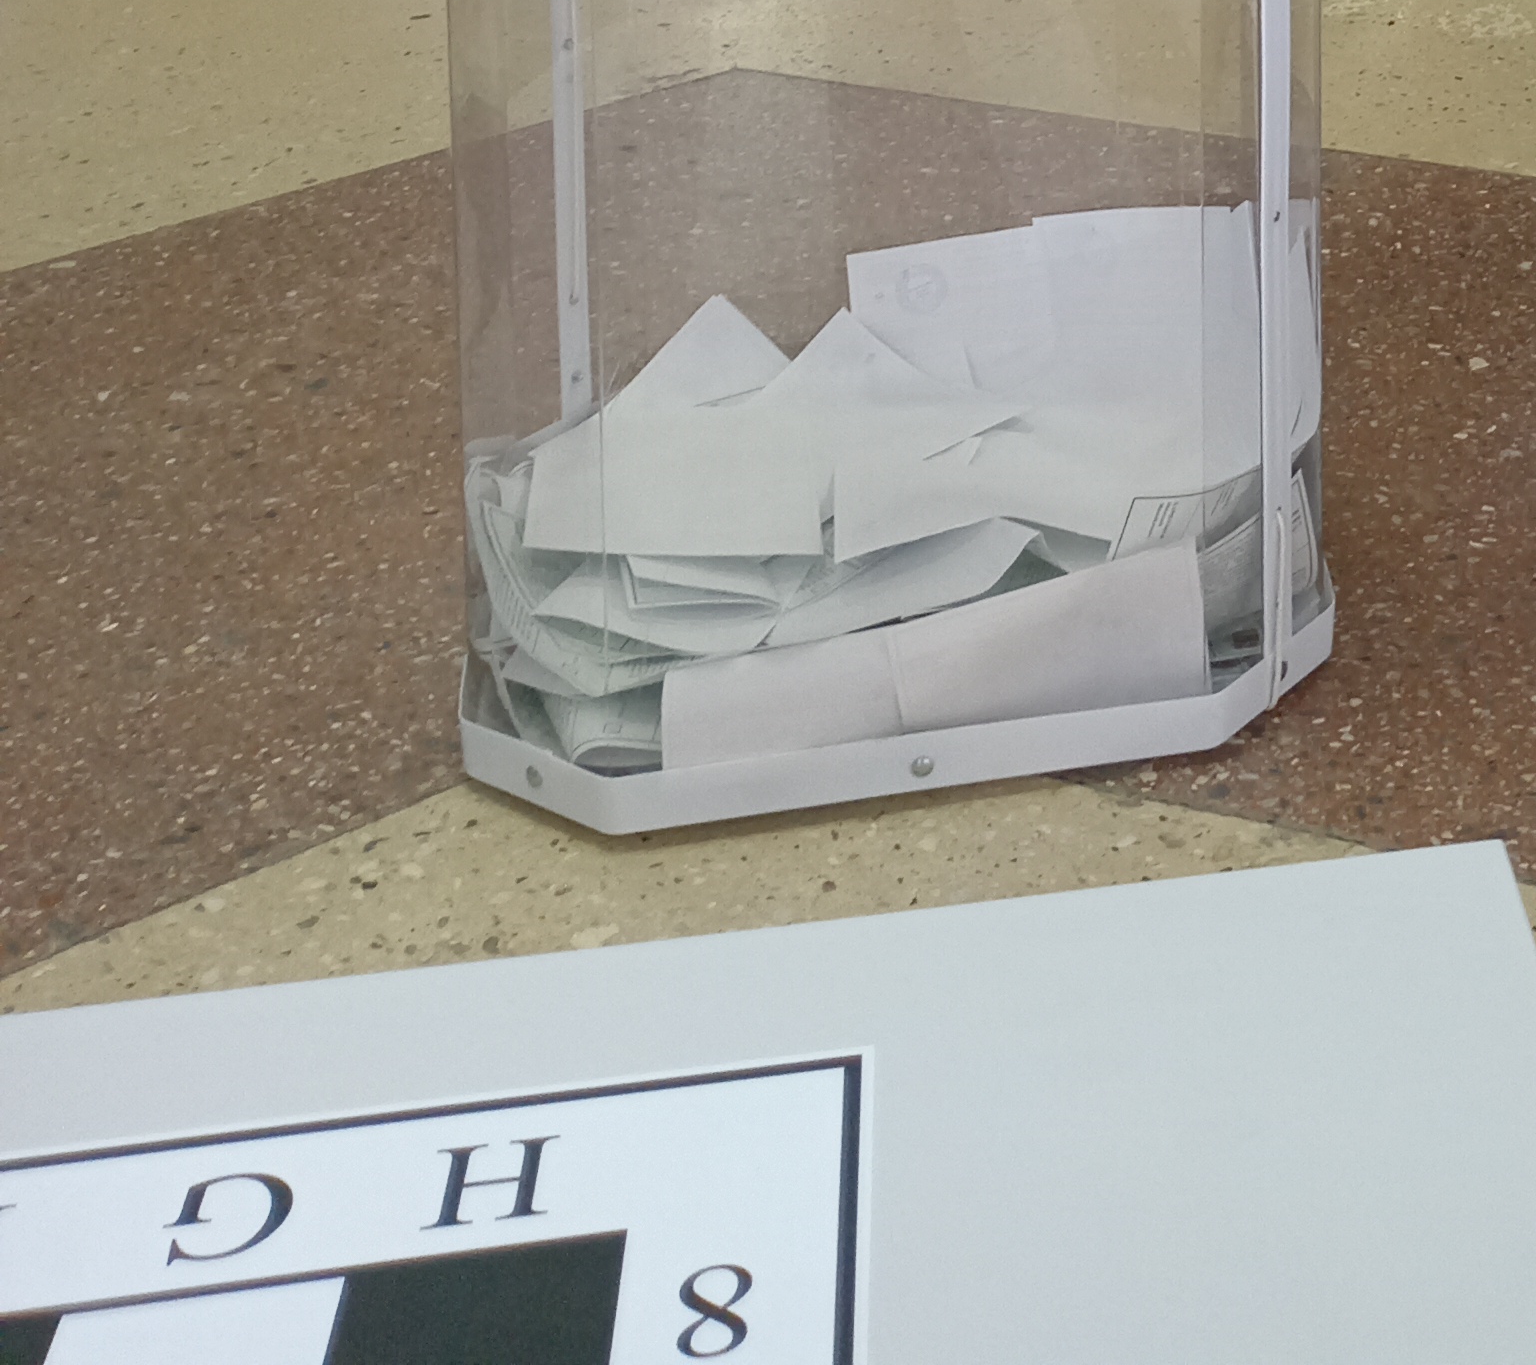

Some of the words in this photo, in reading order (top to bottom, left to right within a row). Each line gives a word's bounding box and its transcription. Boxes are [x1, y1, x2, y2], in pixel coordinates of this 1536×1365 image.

[162, 1173, 294, 1267] G
[420, 1135, 561, 1231] H
[676, 1264, 754, 1358] 8
